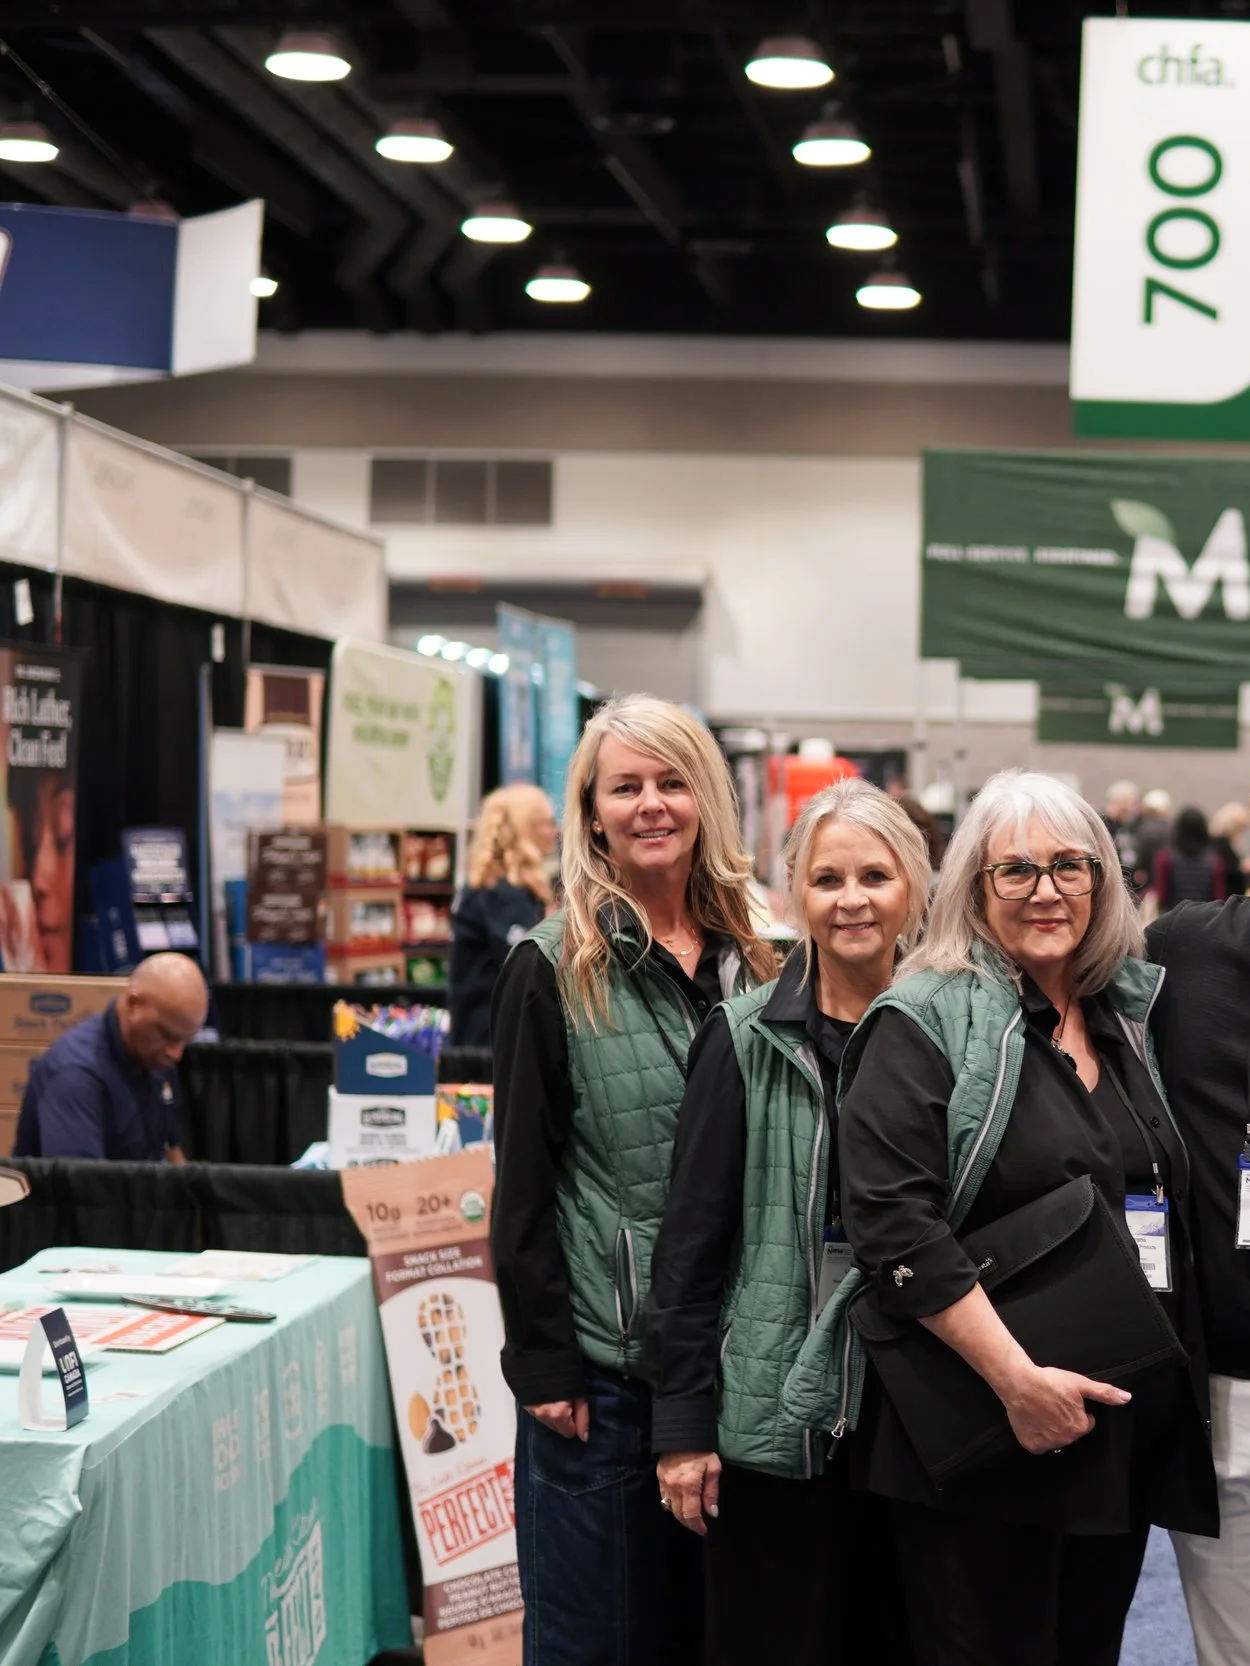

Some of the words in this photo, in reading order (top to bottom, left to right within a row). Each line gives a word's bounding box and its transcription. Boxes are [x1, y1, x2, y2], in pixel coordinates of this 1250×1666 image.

[1143, 134, 1223, 325] 700
[366, 1202, 402, 1223] 10g
[420, 1476, 506, 1559] PERFECT
